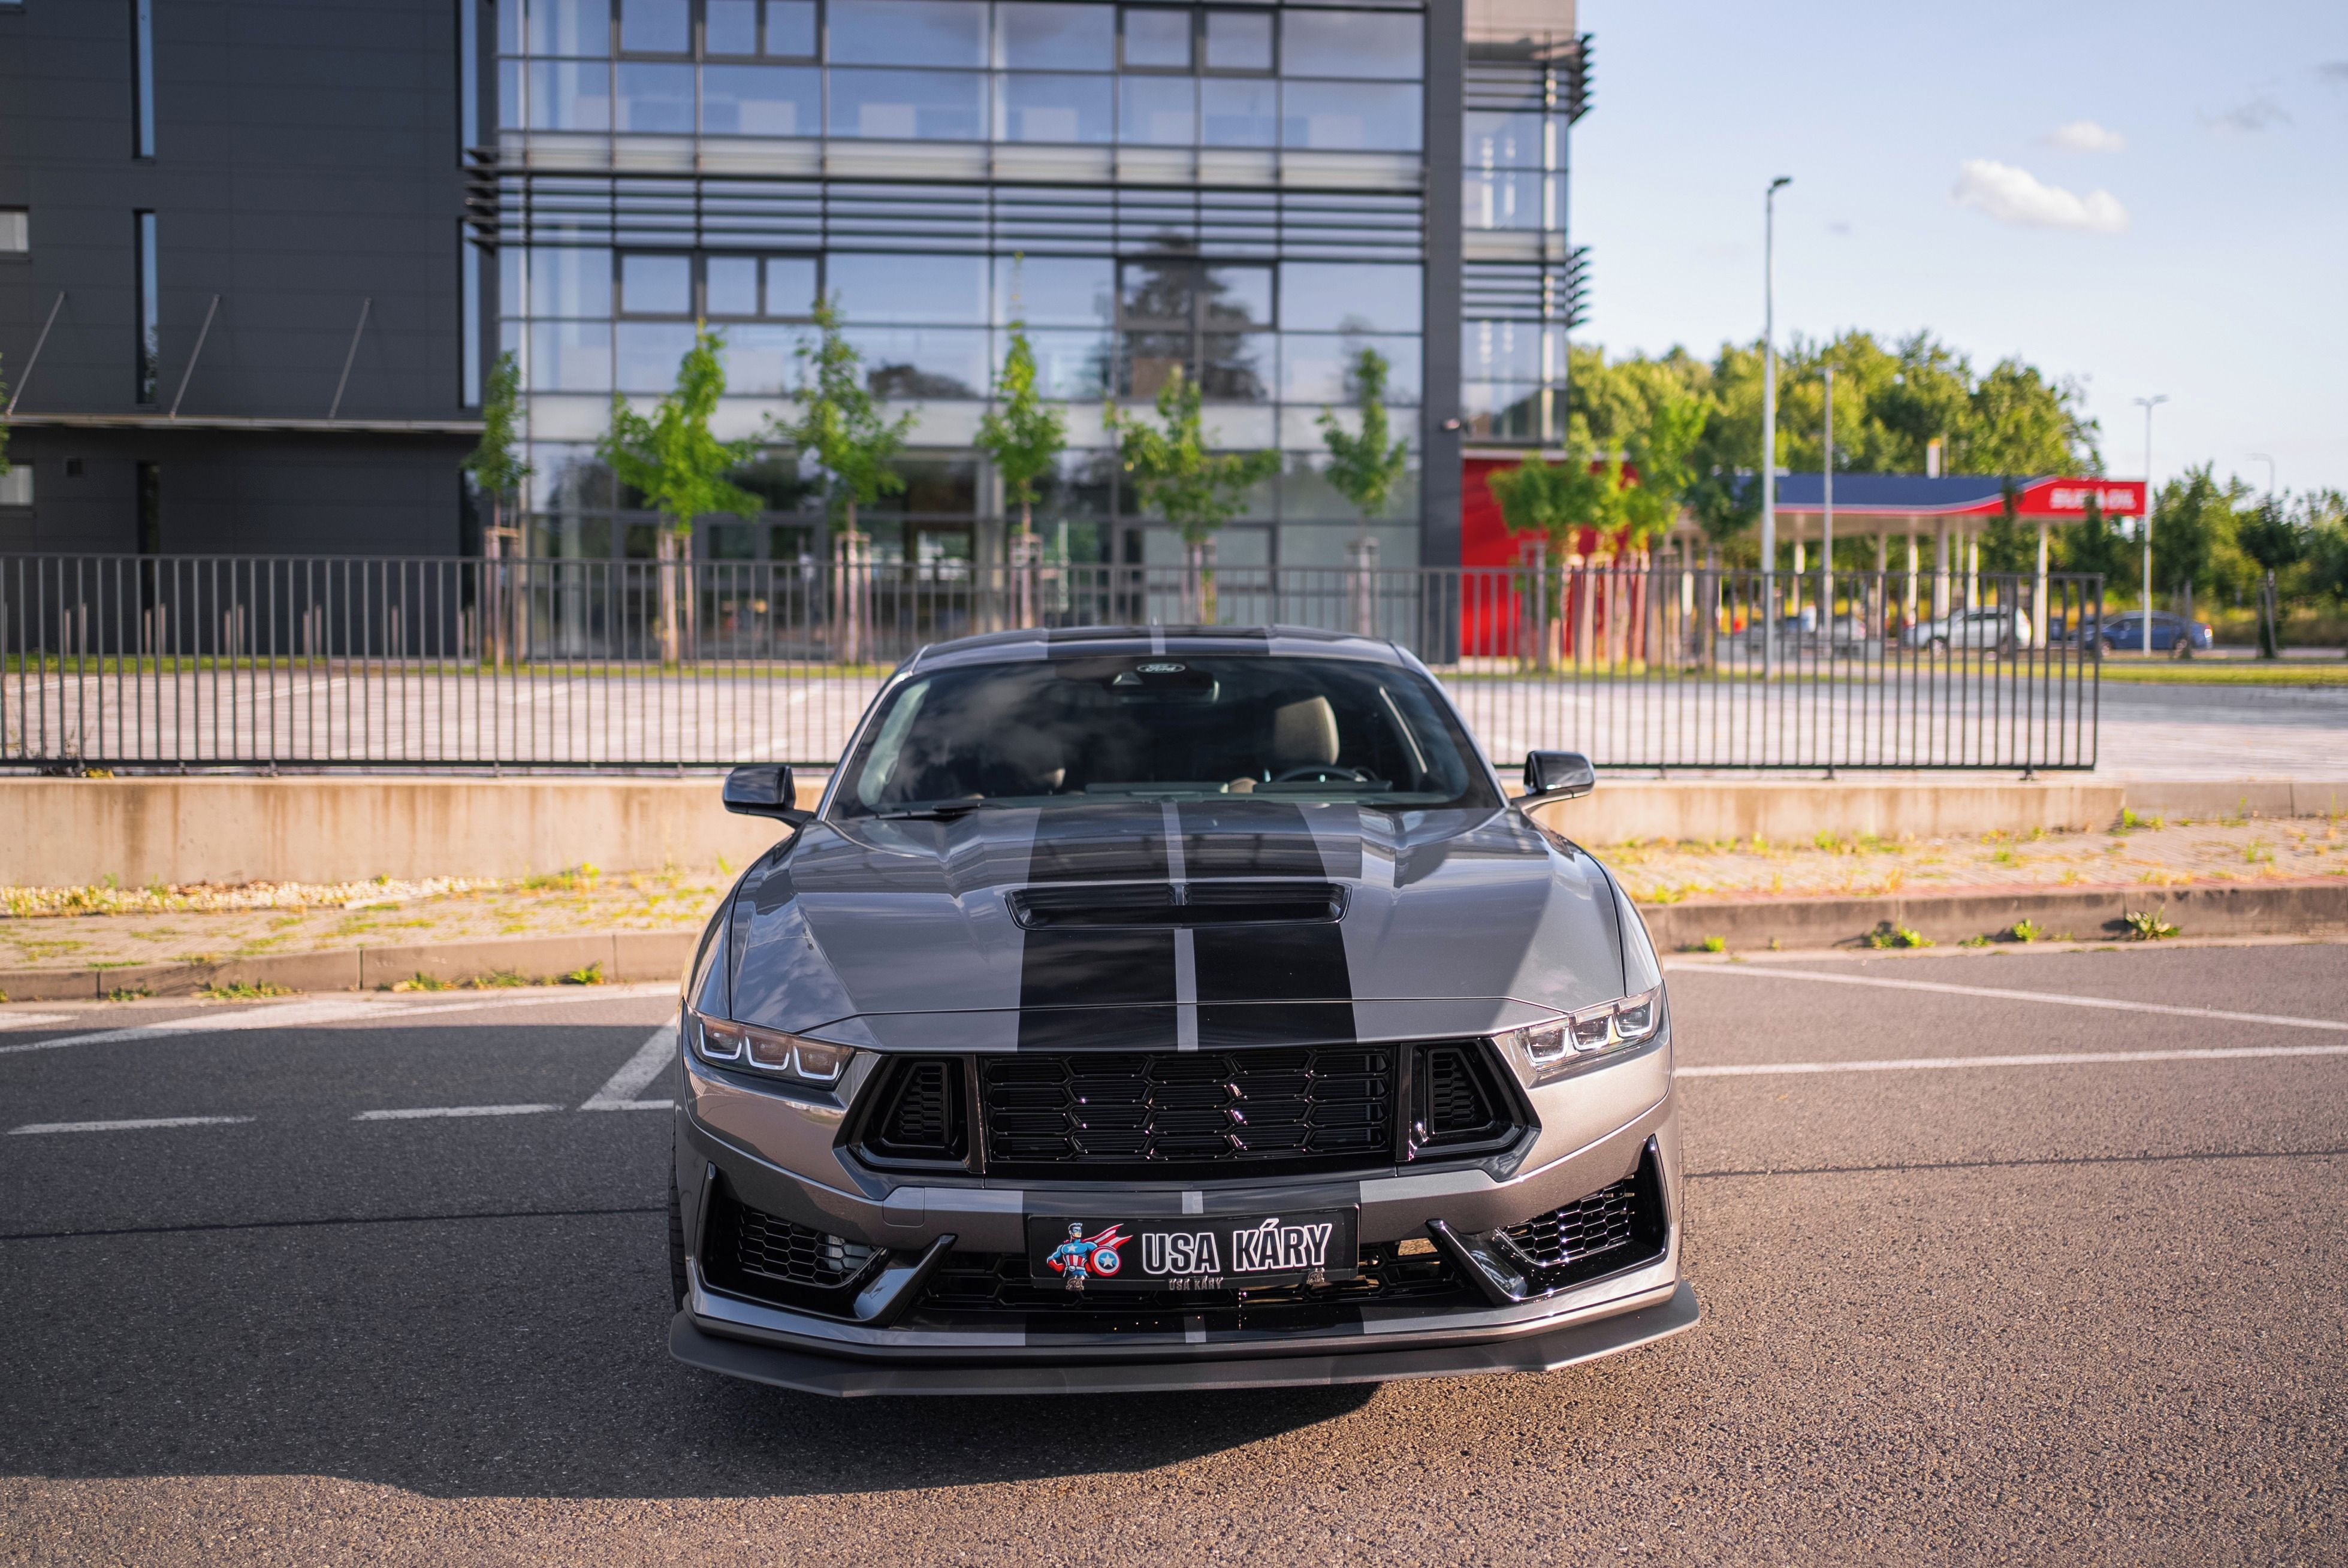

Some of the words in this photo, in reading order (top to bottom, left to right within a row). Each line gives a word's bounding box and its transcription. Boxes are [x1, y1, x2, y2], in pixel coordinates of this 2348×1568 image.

[1142, 1232, 1220, 1274] USA
[1233, 1218, 1332, 1271] KÁRY
[1169, 1278, 1190, 1290] USA
